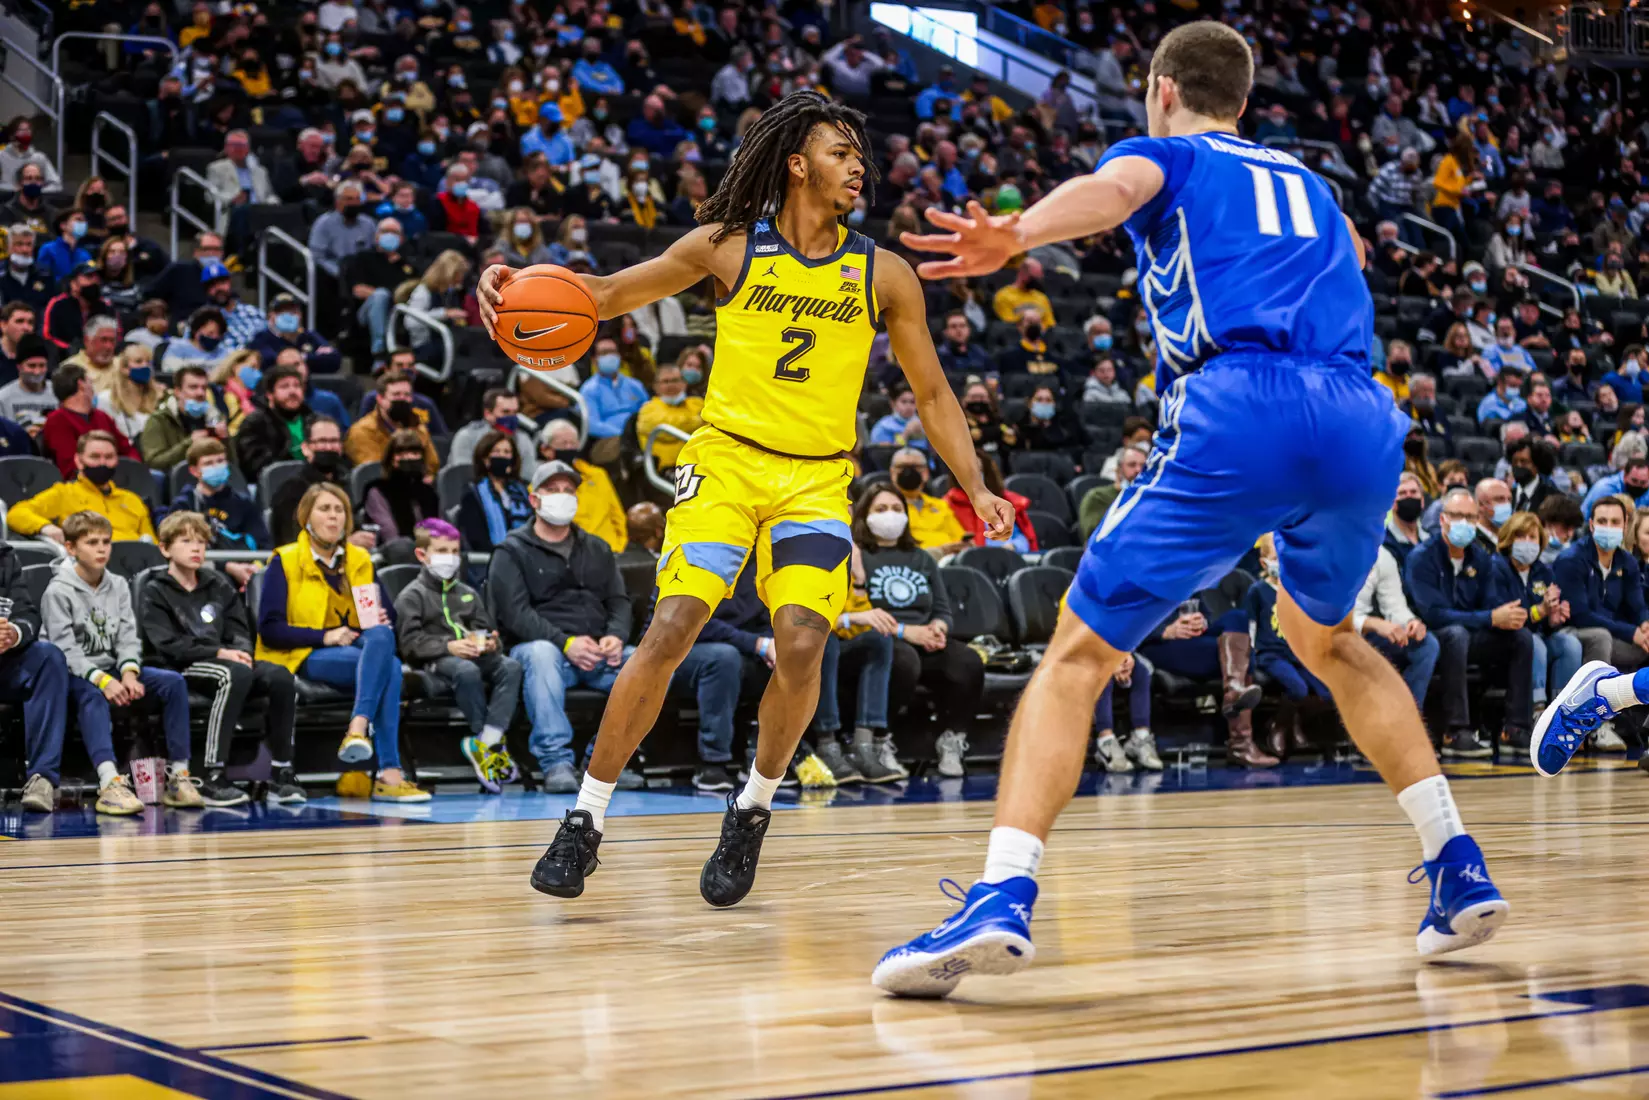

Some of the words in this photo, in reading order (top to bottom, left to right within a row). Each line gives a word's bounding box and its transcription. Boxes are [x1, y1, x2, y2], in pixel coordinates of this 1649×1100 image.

[1241, 162, 1319, 238] 11
[743, 284, 864, 324] Marquette
[516, 353, 566, 367] ELITE
[773, 326, 817, 383] 2
